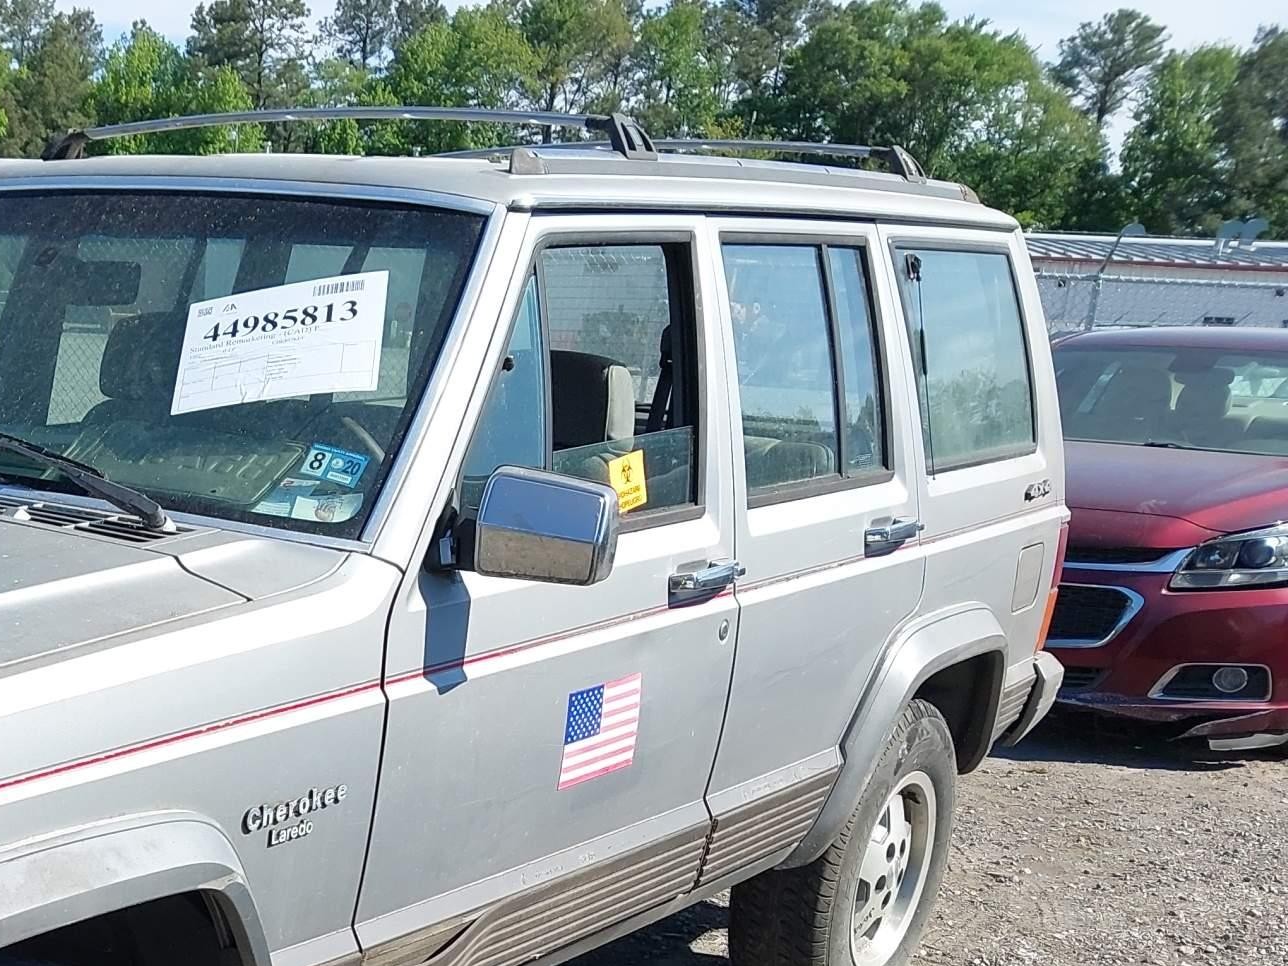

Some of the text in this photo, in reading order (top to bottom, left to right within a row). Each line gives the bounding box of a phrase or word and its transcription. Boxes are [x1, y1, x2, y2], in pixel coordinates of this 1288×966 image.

[203, 299, 359, 342] 44985813
[190, 340, 224, 353] Standard
[225, 332, 276, 346] Remarketing
[309, 452, 326, 470] 8
[342, 459, 361, 476] 20
[241, 783, 348, 835] Cherokee
[266, 819, 314, 848] Laredo
